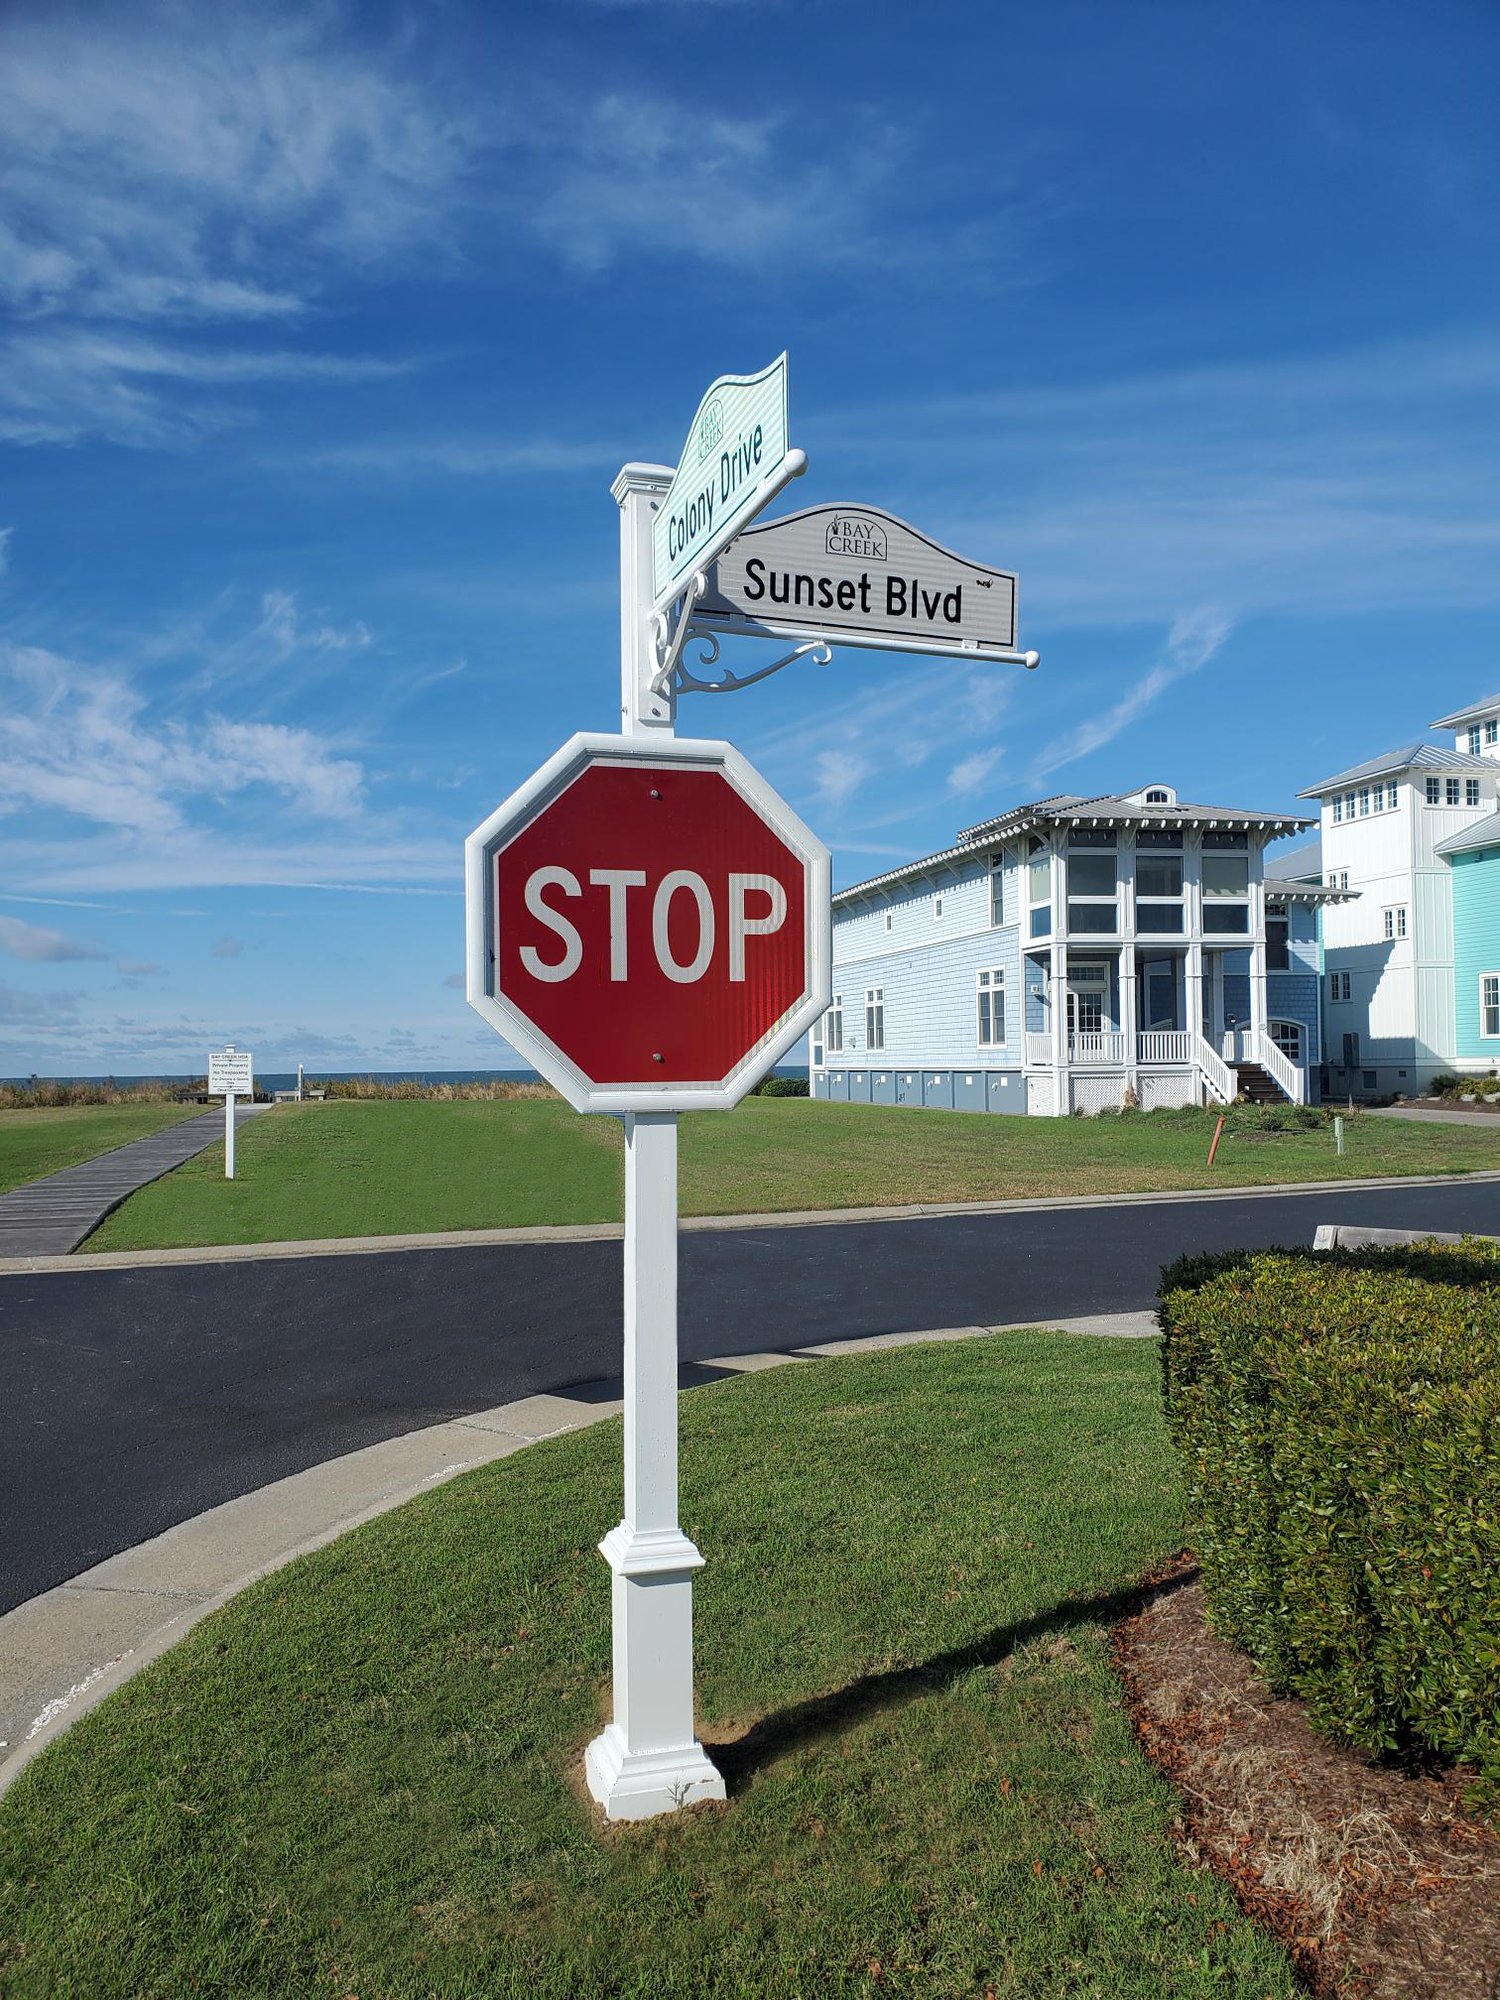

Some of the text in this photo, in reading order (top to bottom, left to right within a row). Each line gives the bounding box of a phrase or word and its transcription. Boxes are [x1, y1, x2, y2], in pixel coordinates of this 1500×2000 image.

[668, 424, 763, 562] Colony Drive
[829, 536, 885, 557] CREEK
[842, 521, 875, 539] BAY
[743, 558, 962, 624] Sunset Blvd
[519, 865, 788, 984] STOP
